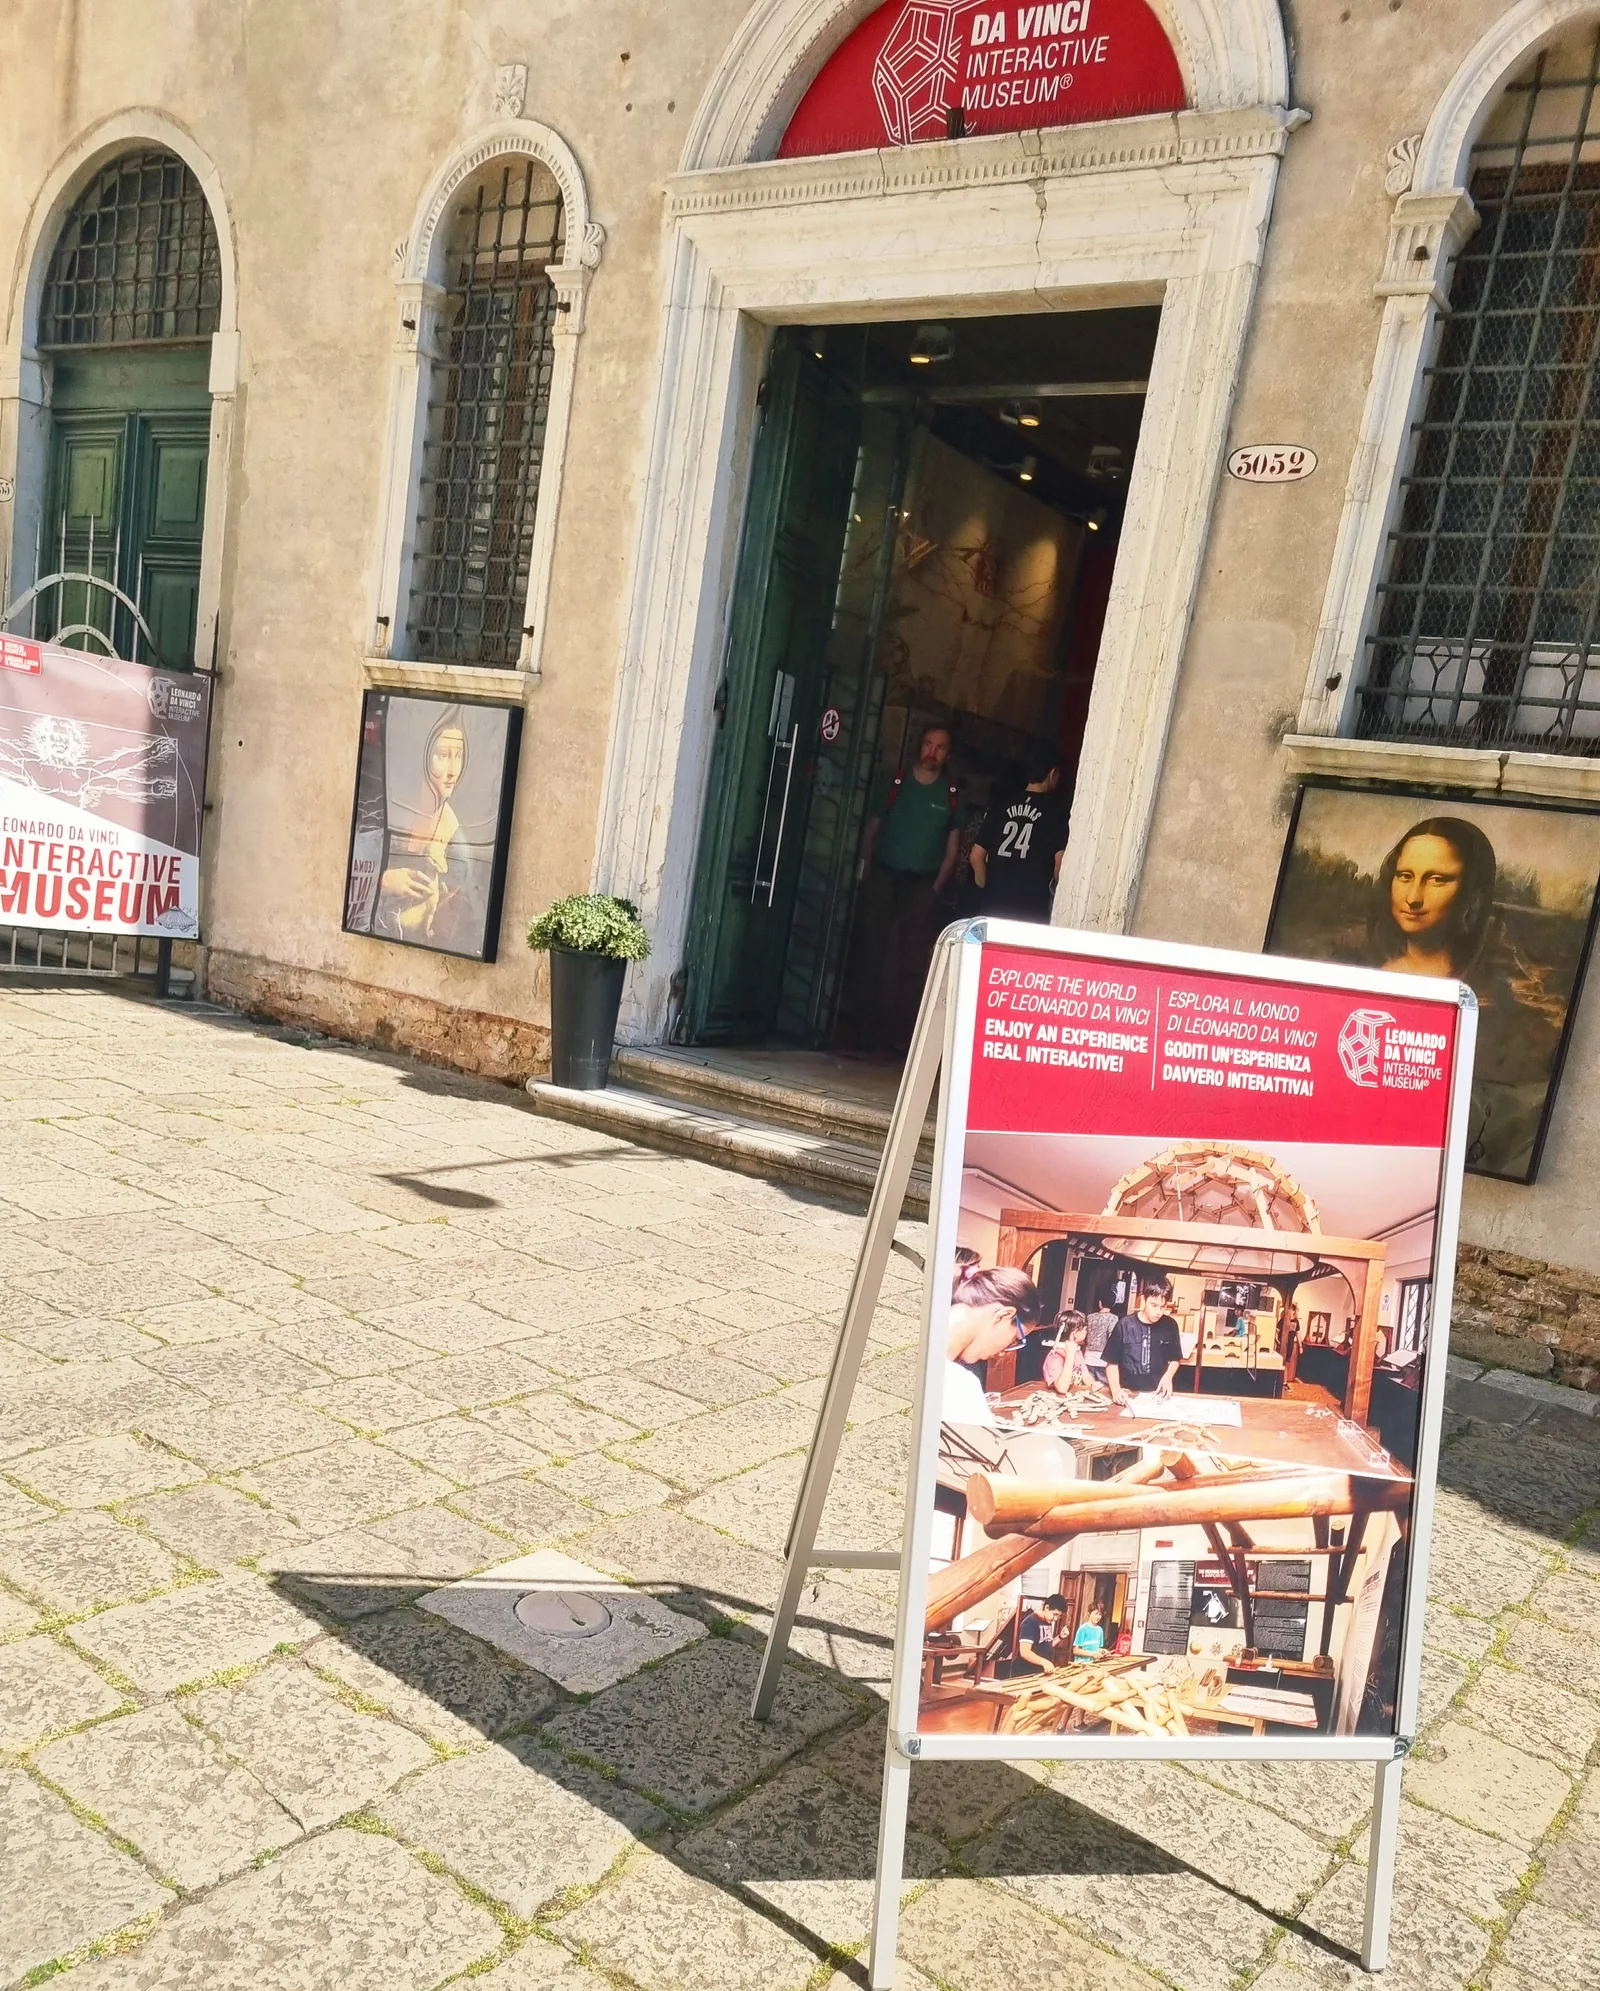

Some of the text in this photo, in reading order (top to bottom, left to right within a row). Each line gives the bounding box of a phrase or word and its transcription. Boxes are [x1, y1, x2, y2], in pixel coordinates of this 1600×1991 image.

[970, 0, 1091, 47] DA VINCI
[966, 35, 1110, 79] INTERACTIVE
[1236, 450, 1306, 477] 3052
[1006, 804, 1042, 822] THOMAS
[0, 816, 119, 846] EONARDO DA VINCI
[997, 821, 1034, 859] 24
[988, 967, 1137, 1002] EXPLORE THE WORLD
[987, 990, 1151, 1026] OF LEONARDO DA VINCI
[1168, 991, 1300, 1022] ESPLORA IL MONDO
[985, 1018, 1149, 1053] ENJOY AN EXPERIENCE
[1167, 1014, 1318, 1048] DI LEONARDO DA VINCI
[1385, 1027, 1447, 1051] LEONARDO
[983, 1041, 1124, 1073] REAL INTERACTIVE!
[1164, 1040, 1311, 1073] GODITI UN'ESPERIENZA
[1383, 1061, 1443, 1080] INTERACTIVE
[1384, 1044, 1437, 1065] DA VINCI
[1162, 1063, 1315, 1097] DAVVERO INTERATTIVA!
